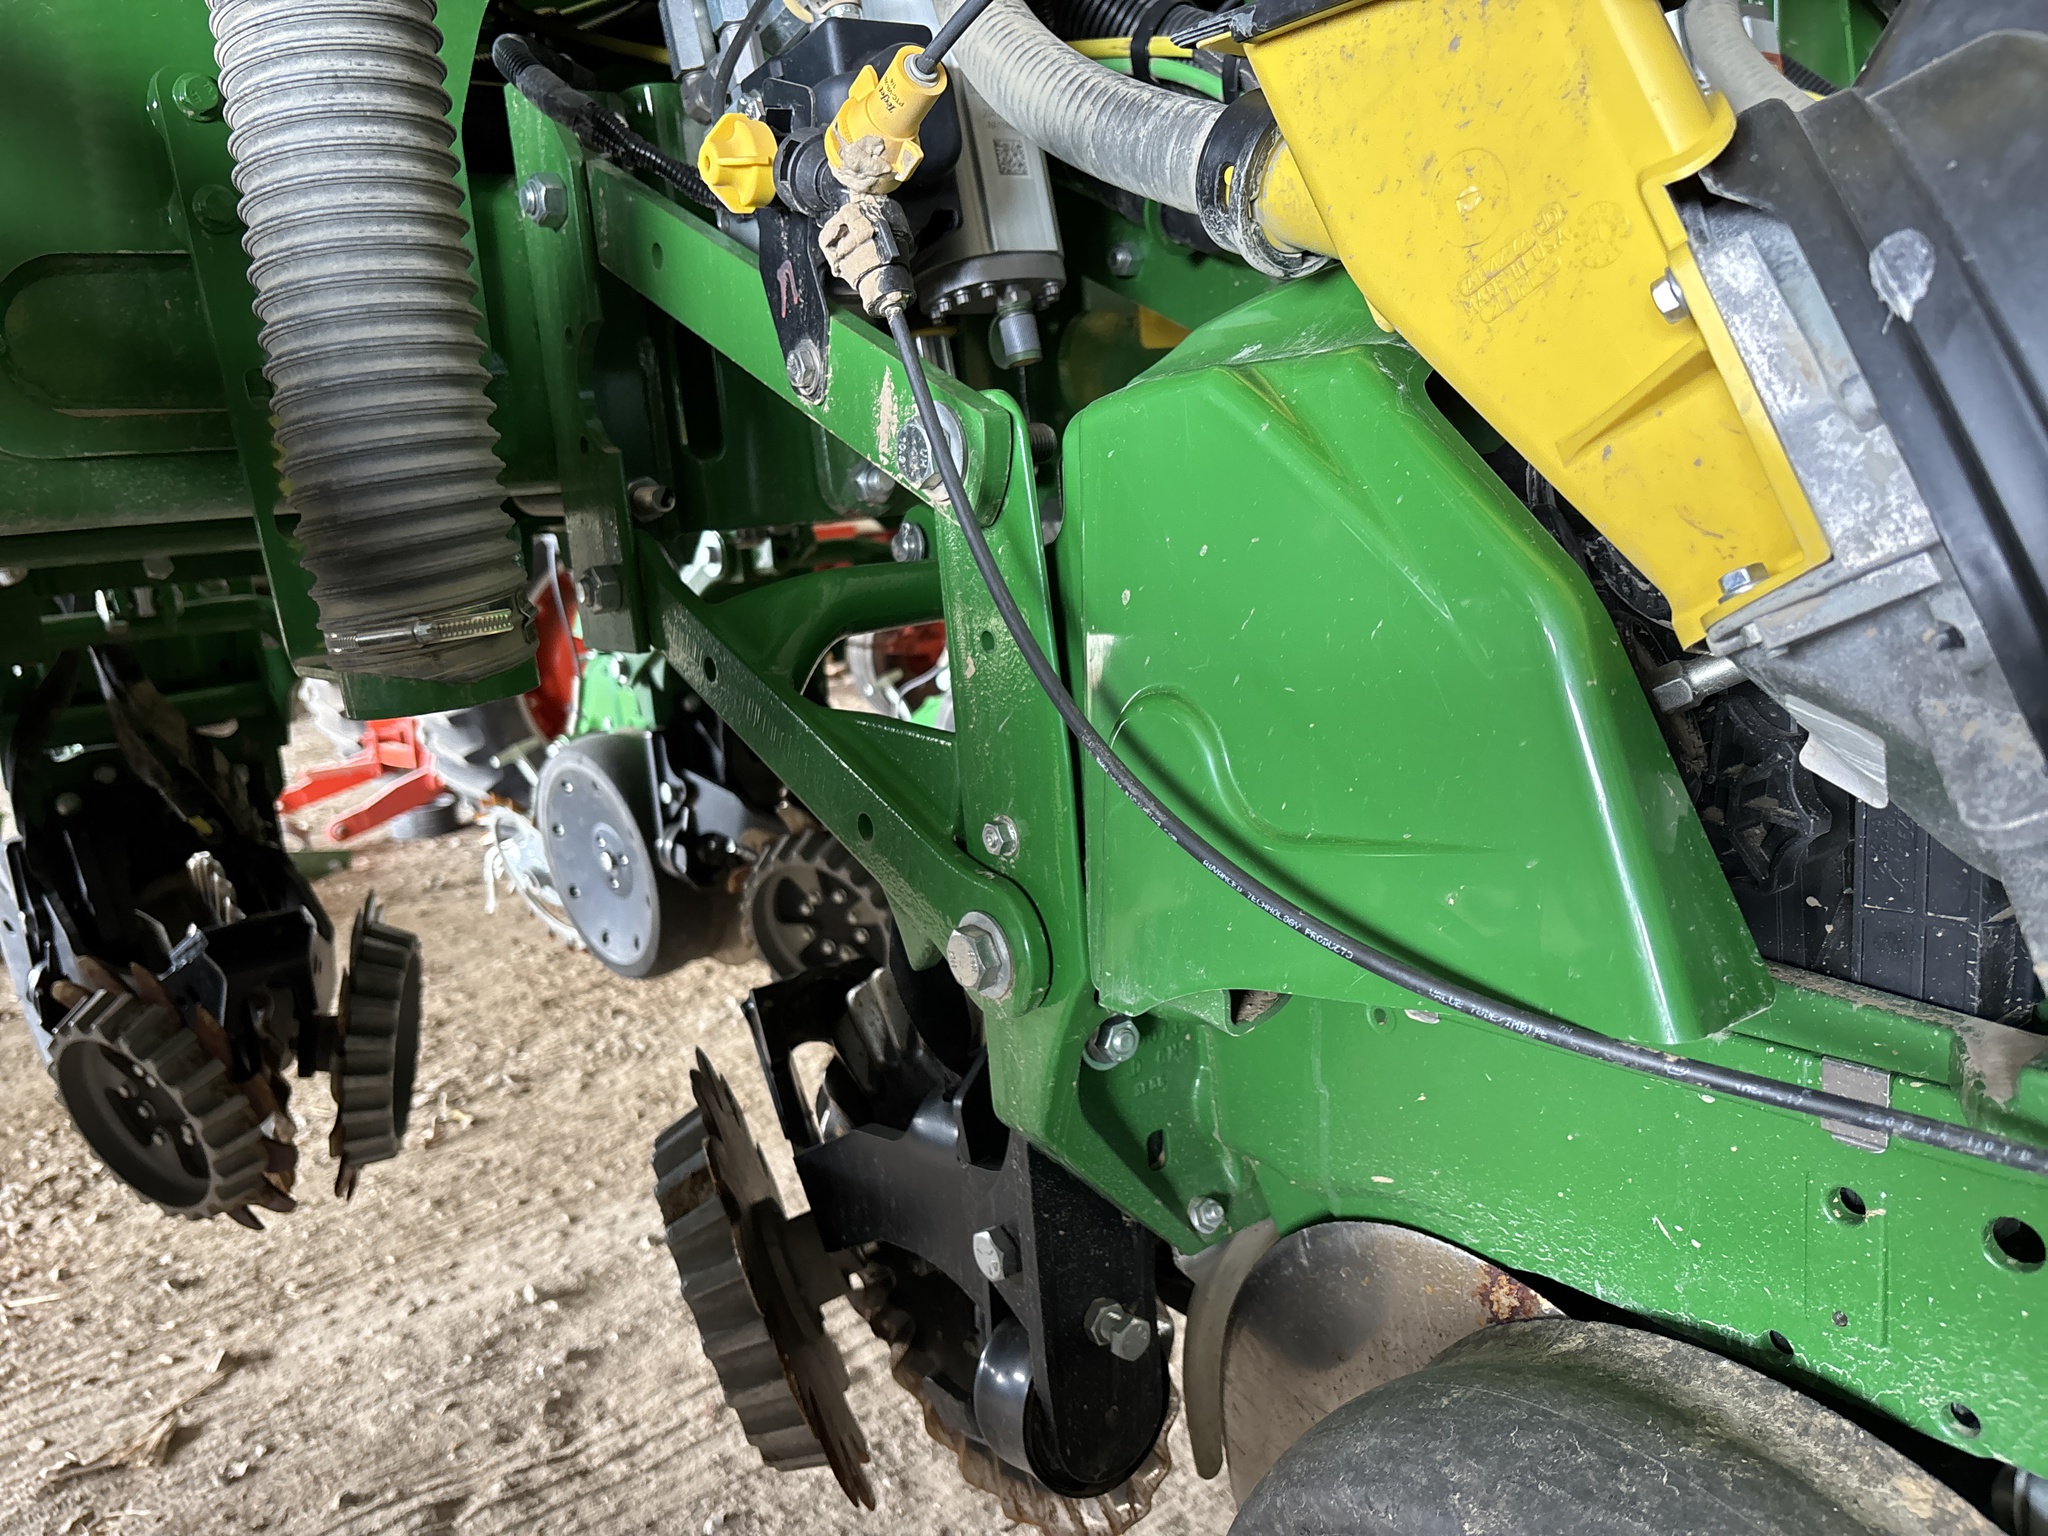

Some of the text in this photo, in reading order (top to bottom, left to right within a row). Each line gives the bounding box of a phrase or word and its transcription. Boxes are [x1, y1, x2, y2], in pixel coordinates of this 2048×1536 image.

[878, 86, 897, 114] TeeJet
[1202, 859, 1354, 959] ADVANCED TECHNOLOGY PRODUCTS
